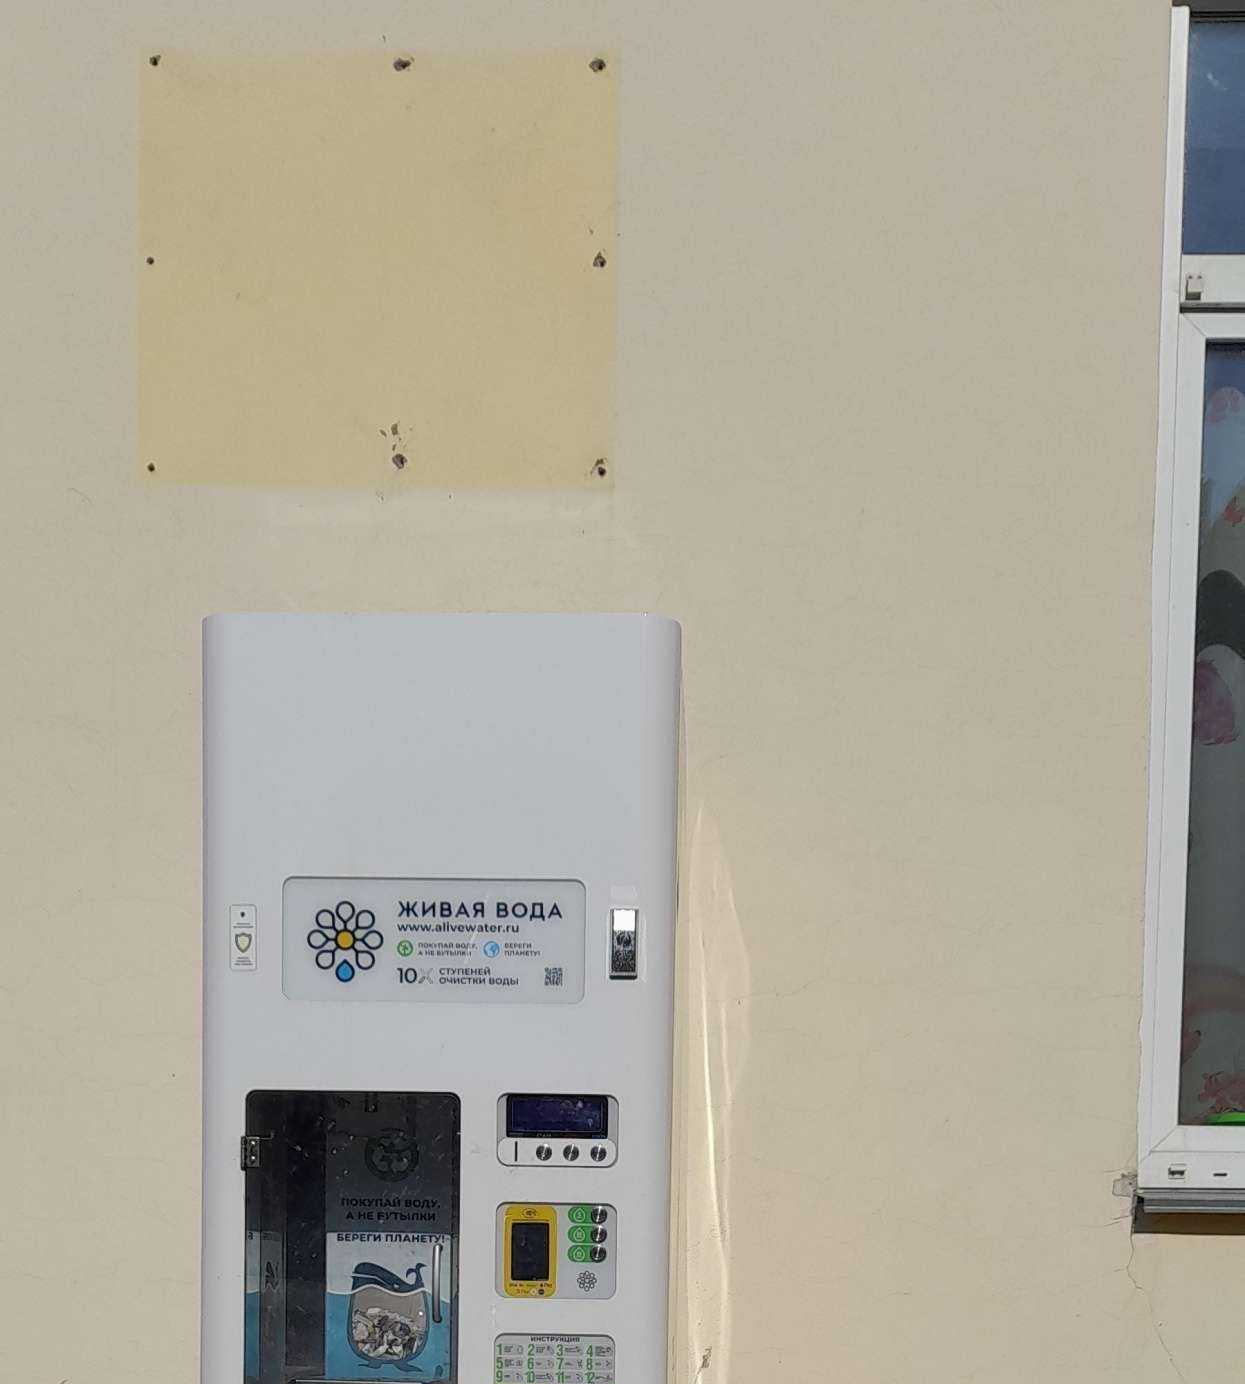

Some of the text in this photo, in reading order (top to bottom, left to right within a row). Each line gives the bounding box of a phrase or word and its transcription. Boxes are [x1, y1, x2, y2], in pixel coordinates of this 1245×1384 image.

[398, 900, 563, 921] ЖИВАЯ ВОДА
[397, 921, 520, 933] www.alivewater.ru
[438, 967, 491, 976] СТУПЕНЕЙ
[438, 976, 519, 986] ОЧИСТКИ ВОДЫ
[342, 1197, 400, 1208] ПОКУПАЙ
[346, 1211, 436, 1221] А НЕ БУТЫЛКИ
[337, 1233, 445, 1243] БЕРЕГИ ПЛАНЕТУ!
[496, 1344, 503, 1355] 1
[528, 1344, 535, 1356] 2
[556, 1344, 564, 1356] 3
[586, 1345, 594, 1357] 4
[496, 1357, 503, 1369] 5
[527, 1357, 535, 1369] 6
[556, 1358, 564, 1369] 7
[586, 1358, 593, 1370] 8
[496, 1370, 503, 1382] 9
[525, 1371, 535, 1383] 10
[556, 1371, 565, 1383] 11
[585, 1371, 595, 1384] 12
